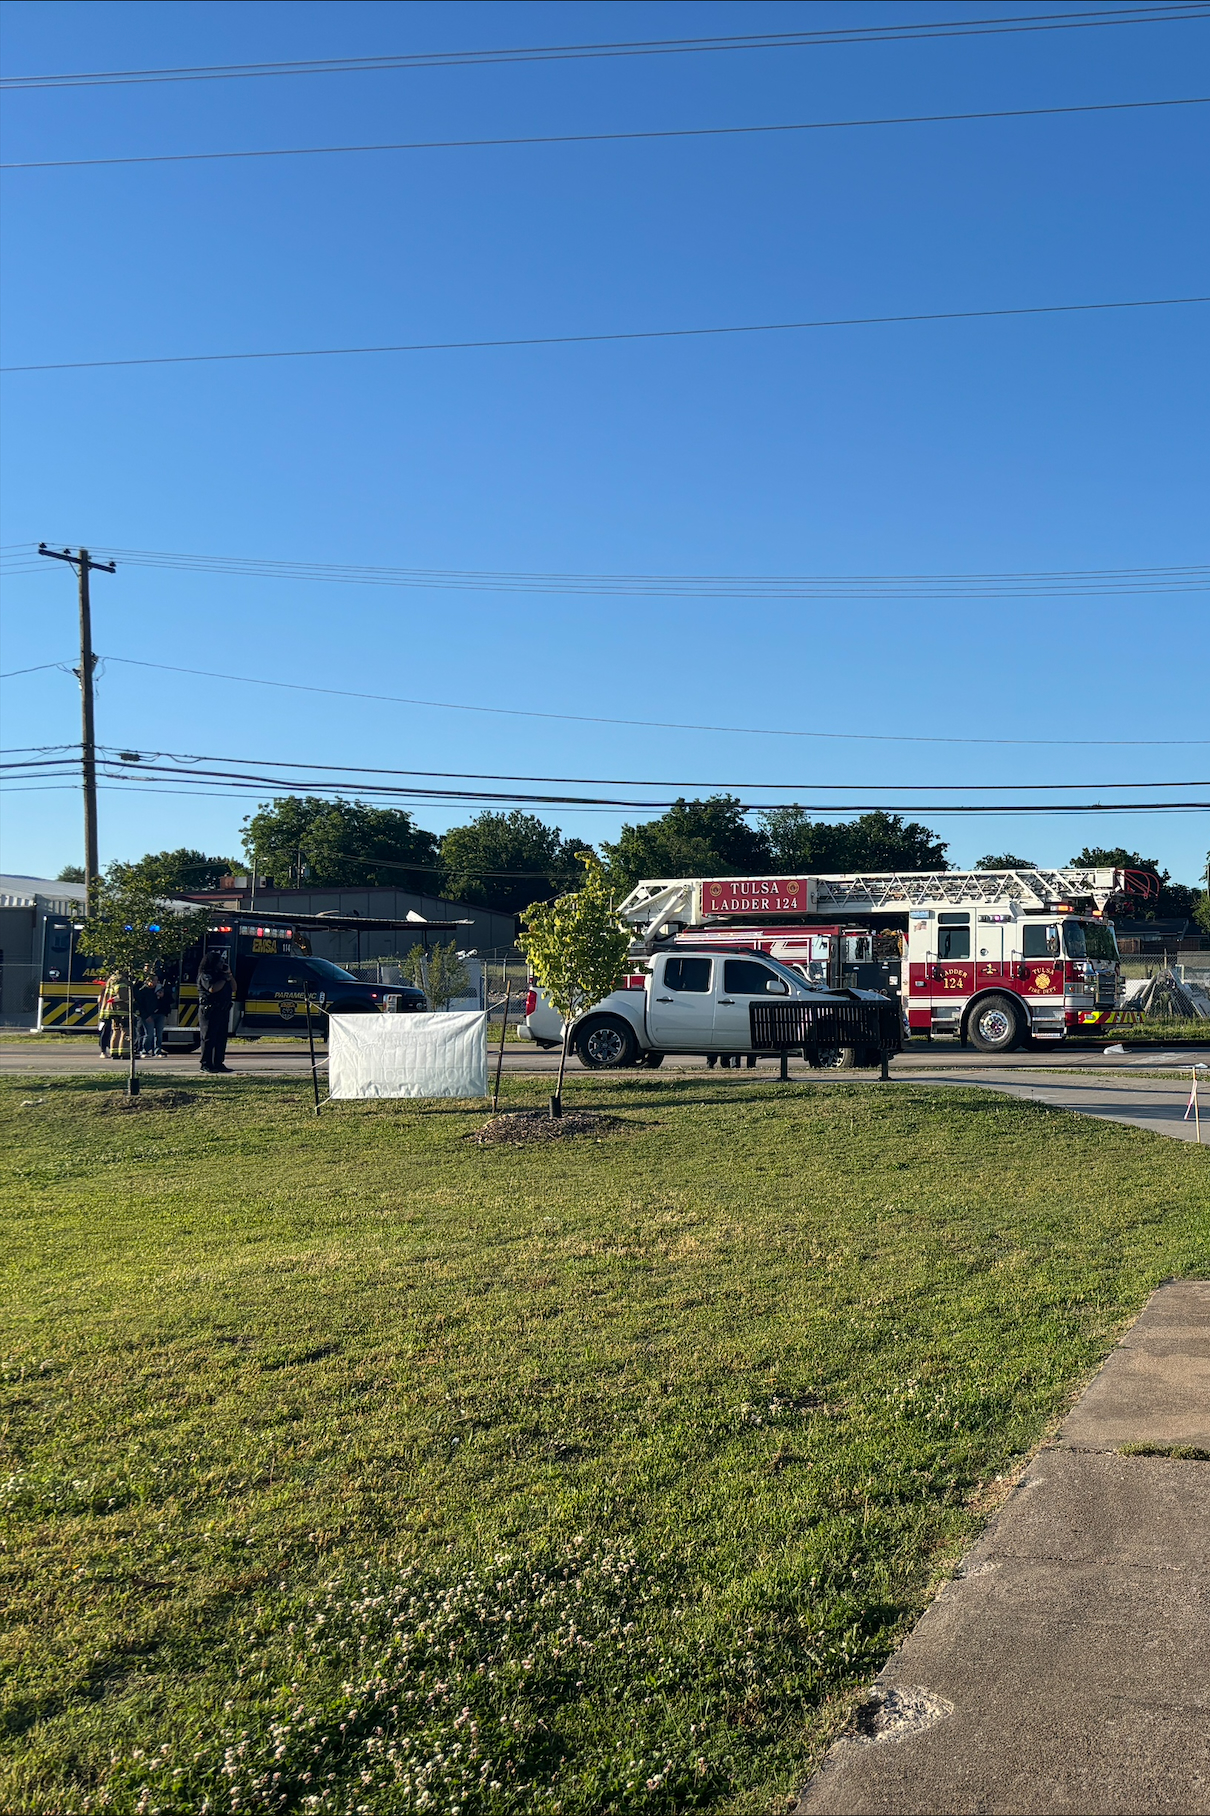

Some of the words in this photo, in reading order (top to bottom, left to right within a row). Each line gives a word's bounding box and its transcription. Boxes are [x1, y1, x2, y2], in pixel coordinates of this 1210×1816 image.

[730, 882, 779, 895] TULSA
[711, 898, 770, 911] LADDER
[775, 897, 798, 909] 124
[252, 938, 278, 953] EMSA
[940, 968, 968, 978] LADDER
[1032, 967, 1055, 975] TULSA
[943, 977, 964, 989] 124
[1027, 985, 1041, 995] FIRE
[1042, 985, 1057, 995] DEPT
